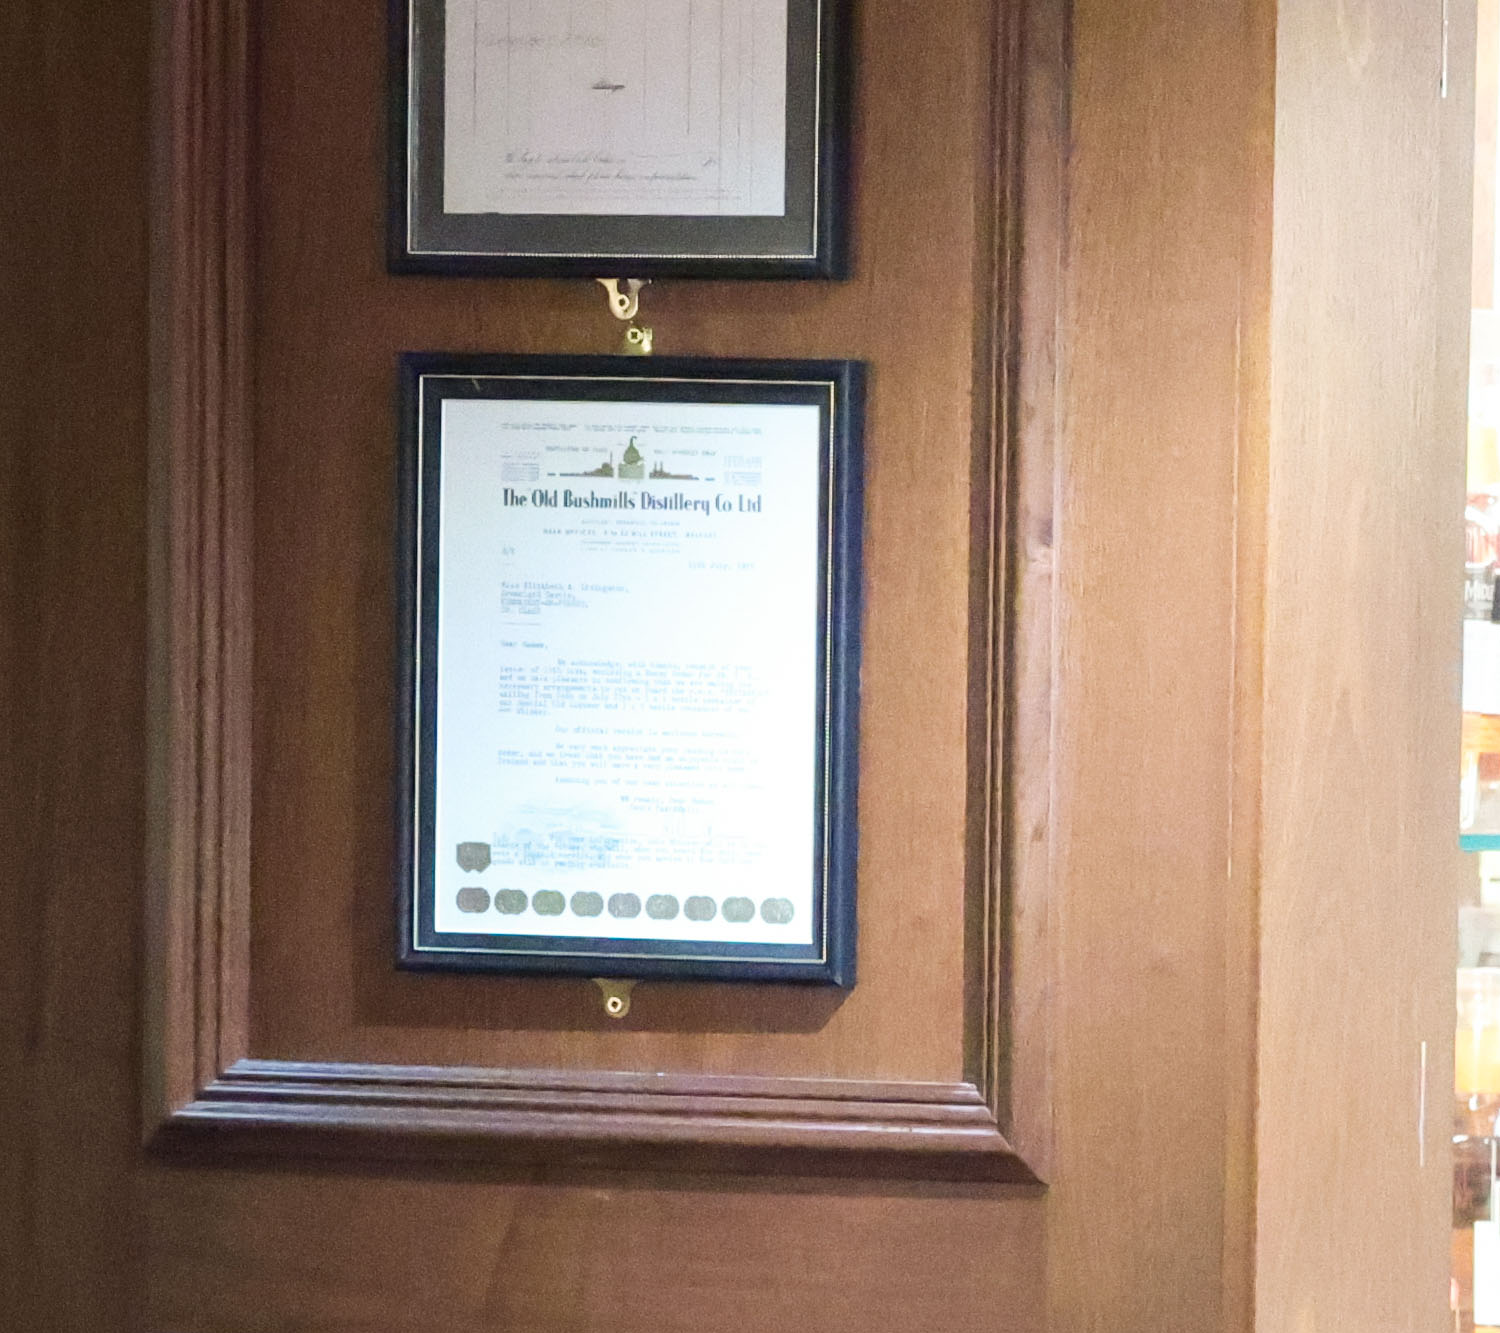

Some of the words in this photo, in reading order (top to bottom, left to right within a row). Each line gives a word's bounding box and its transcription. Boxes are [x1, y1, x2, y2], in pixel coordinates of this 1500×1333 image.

[502, 488, 527, 507] The
[641, 491, 710, 516] Distillery
[715, 493, 732, 512] Co
[739, 494, 762, 513] Ltd
